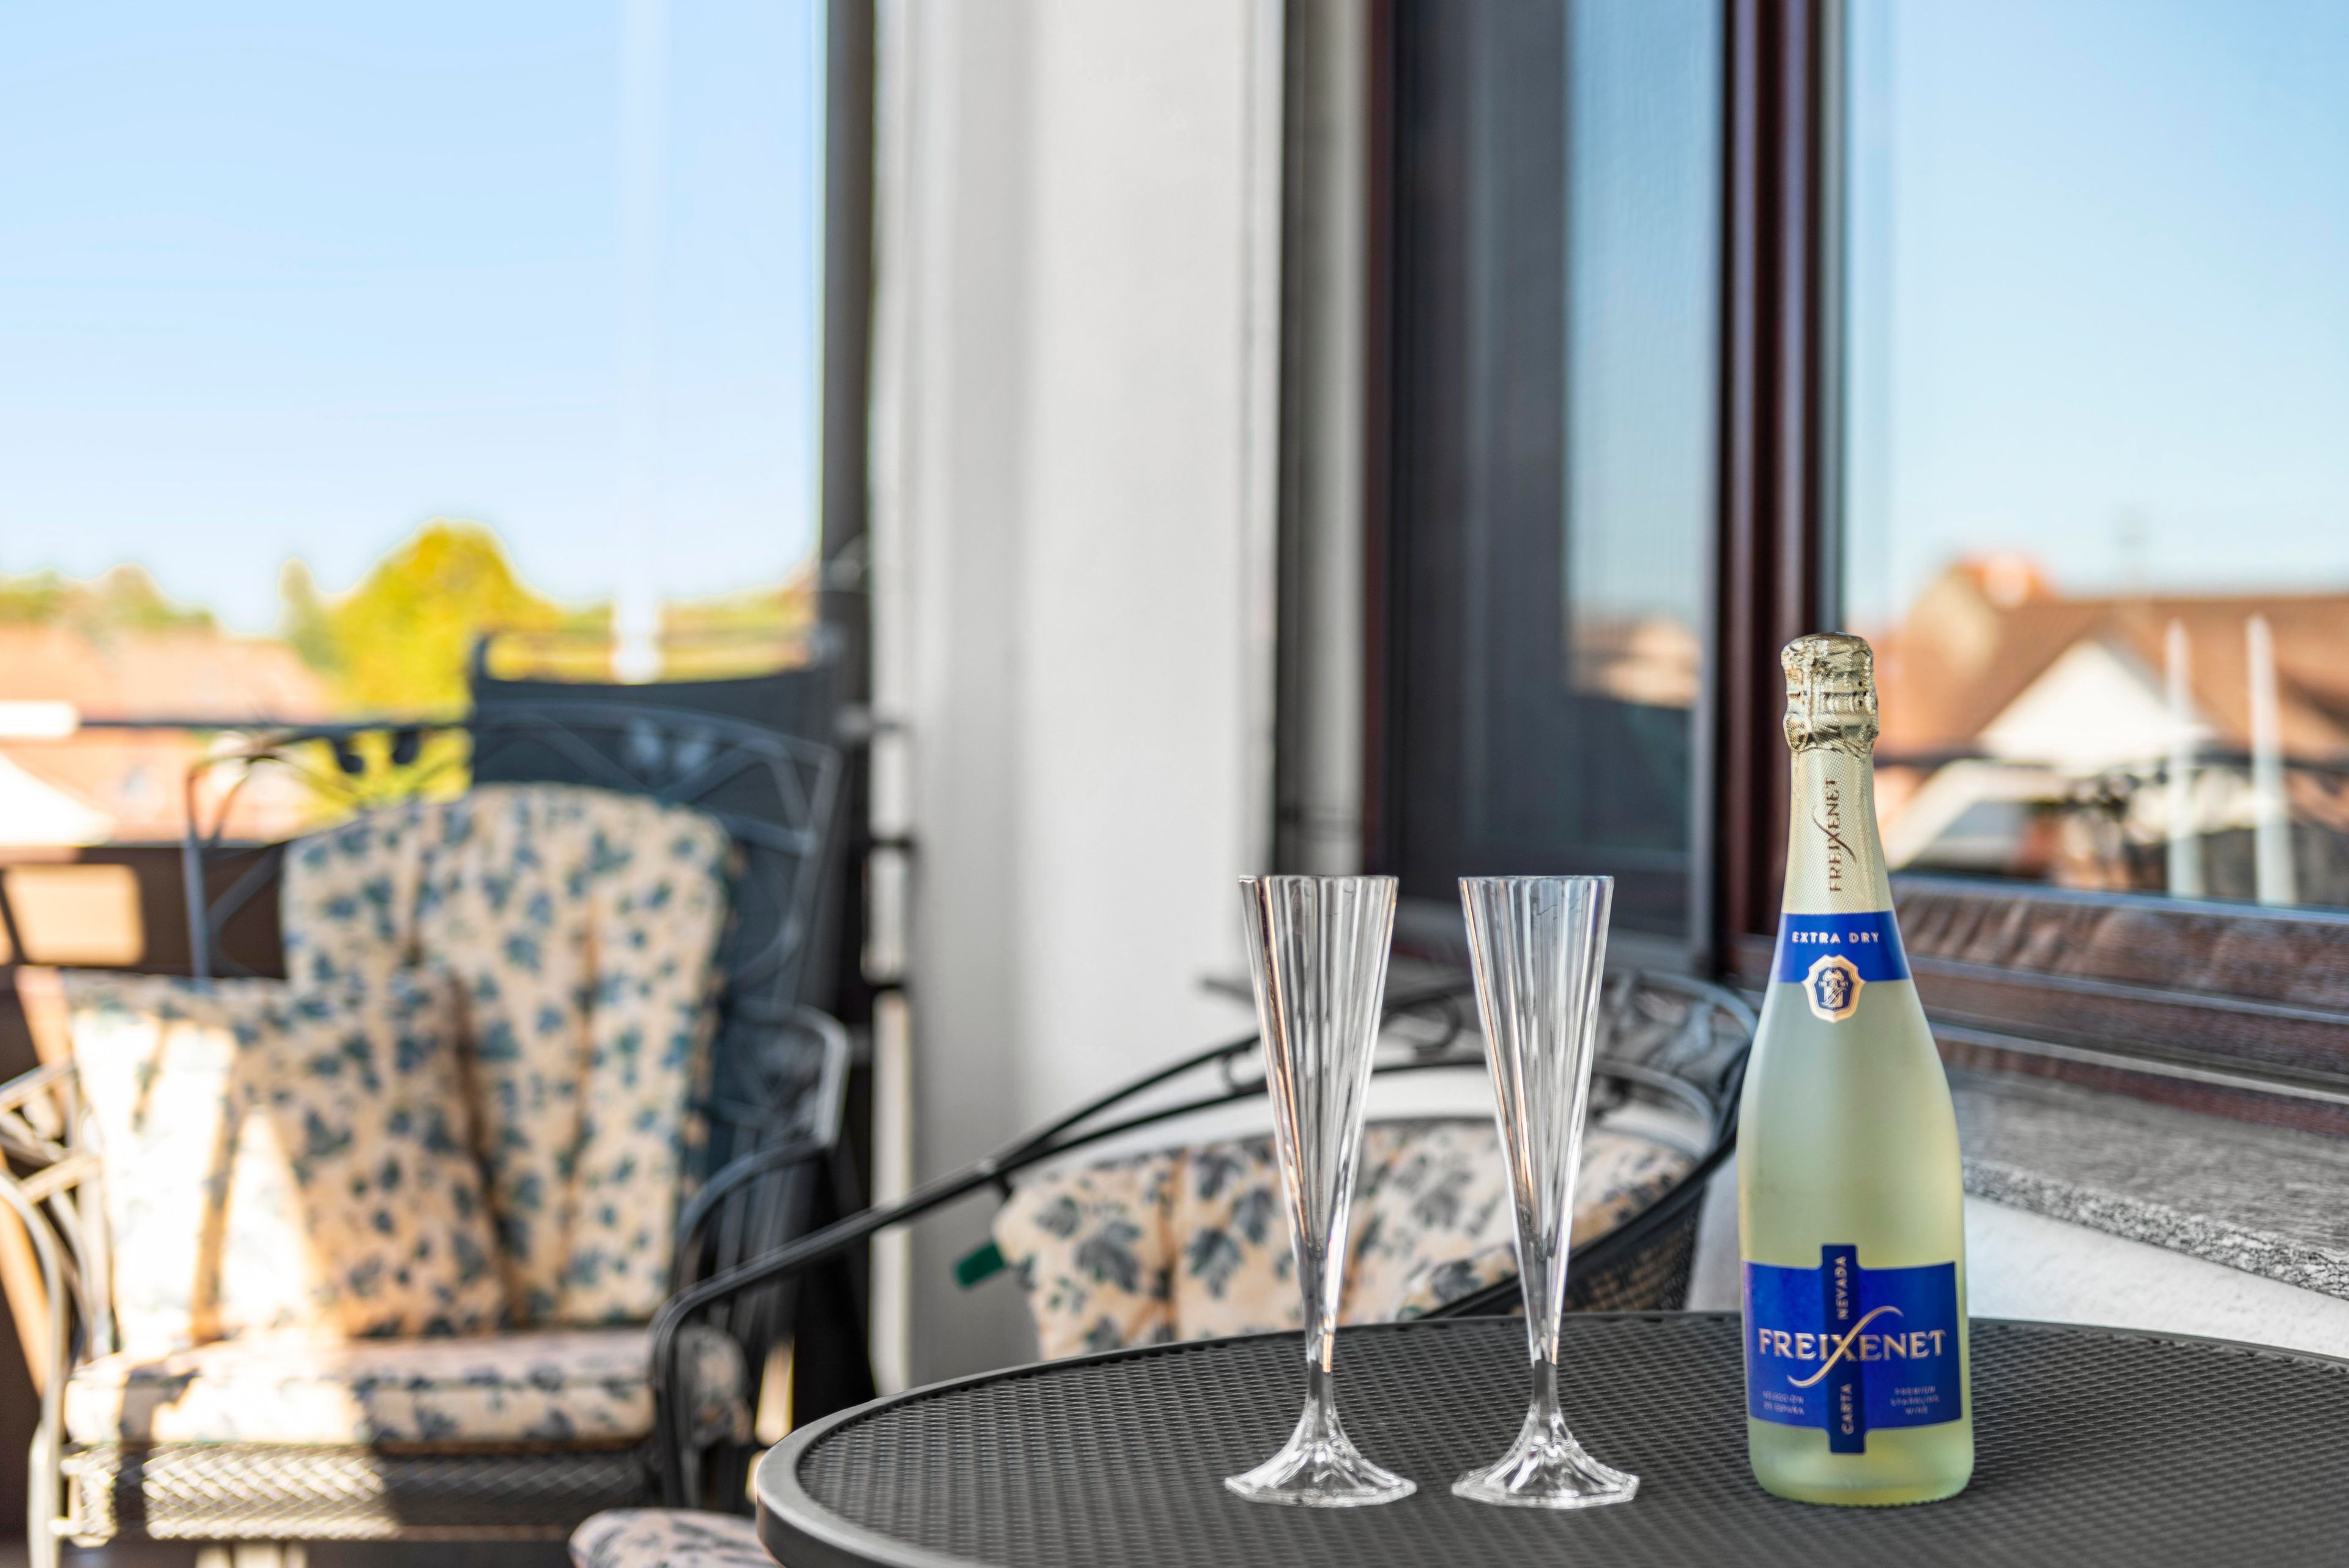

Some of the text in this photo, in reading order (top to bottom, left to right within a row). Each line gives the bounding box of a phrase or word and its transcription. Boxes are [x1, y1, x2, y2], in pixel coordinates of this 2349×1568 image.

[1792, 931, 1879, 943] EXTRA DRY
[1835, 1256, 1854, 1435] CARTA NEVADA
